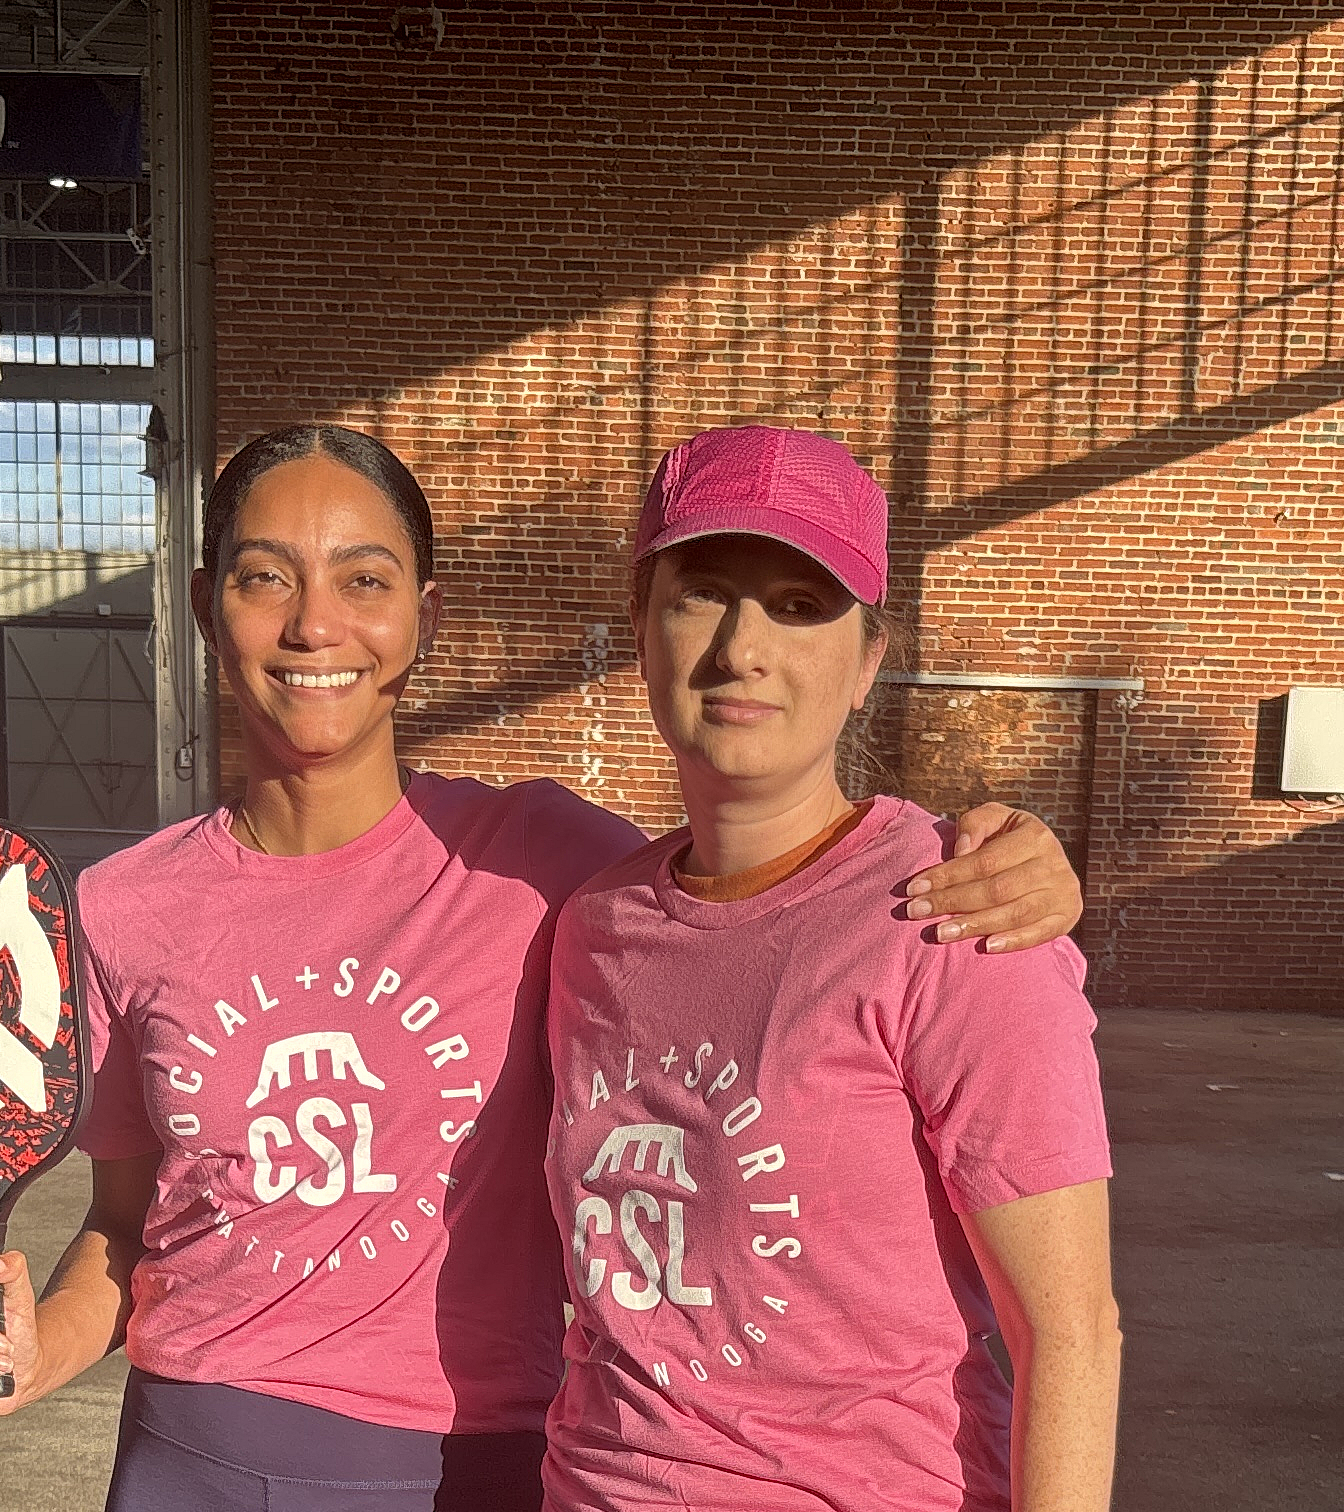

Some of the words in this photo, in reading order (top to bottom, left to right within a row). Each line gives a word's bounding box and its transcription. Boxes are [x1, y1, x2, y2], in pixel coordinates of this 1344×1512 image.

[168, 974, 279, 1161] OCIAL
[333, 957, 483, 1149] SPORTS
[246, 1097, 398, 1206] CSL
[684, 1042, 802, 1260] SPORTS
[573, 1190, 712, 1310] CSL
